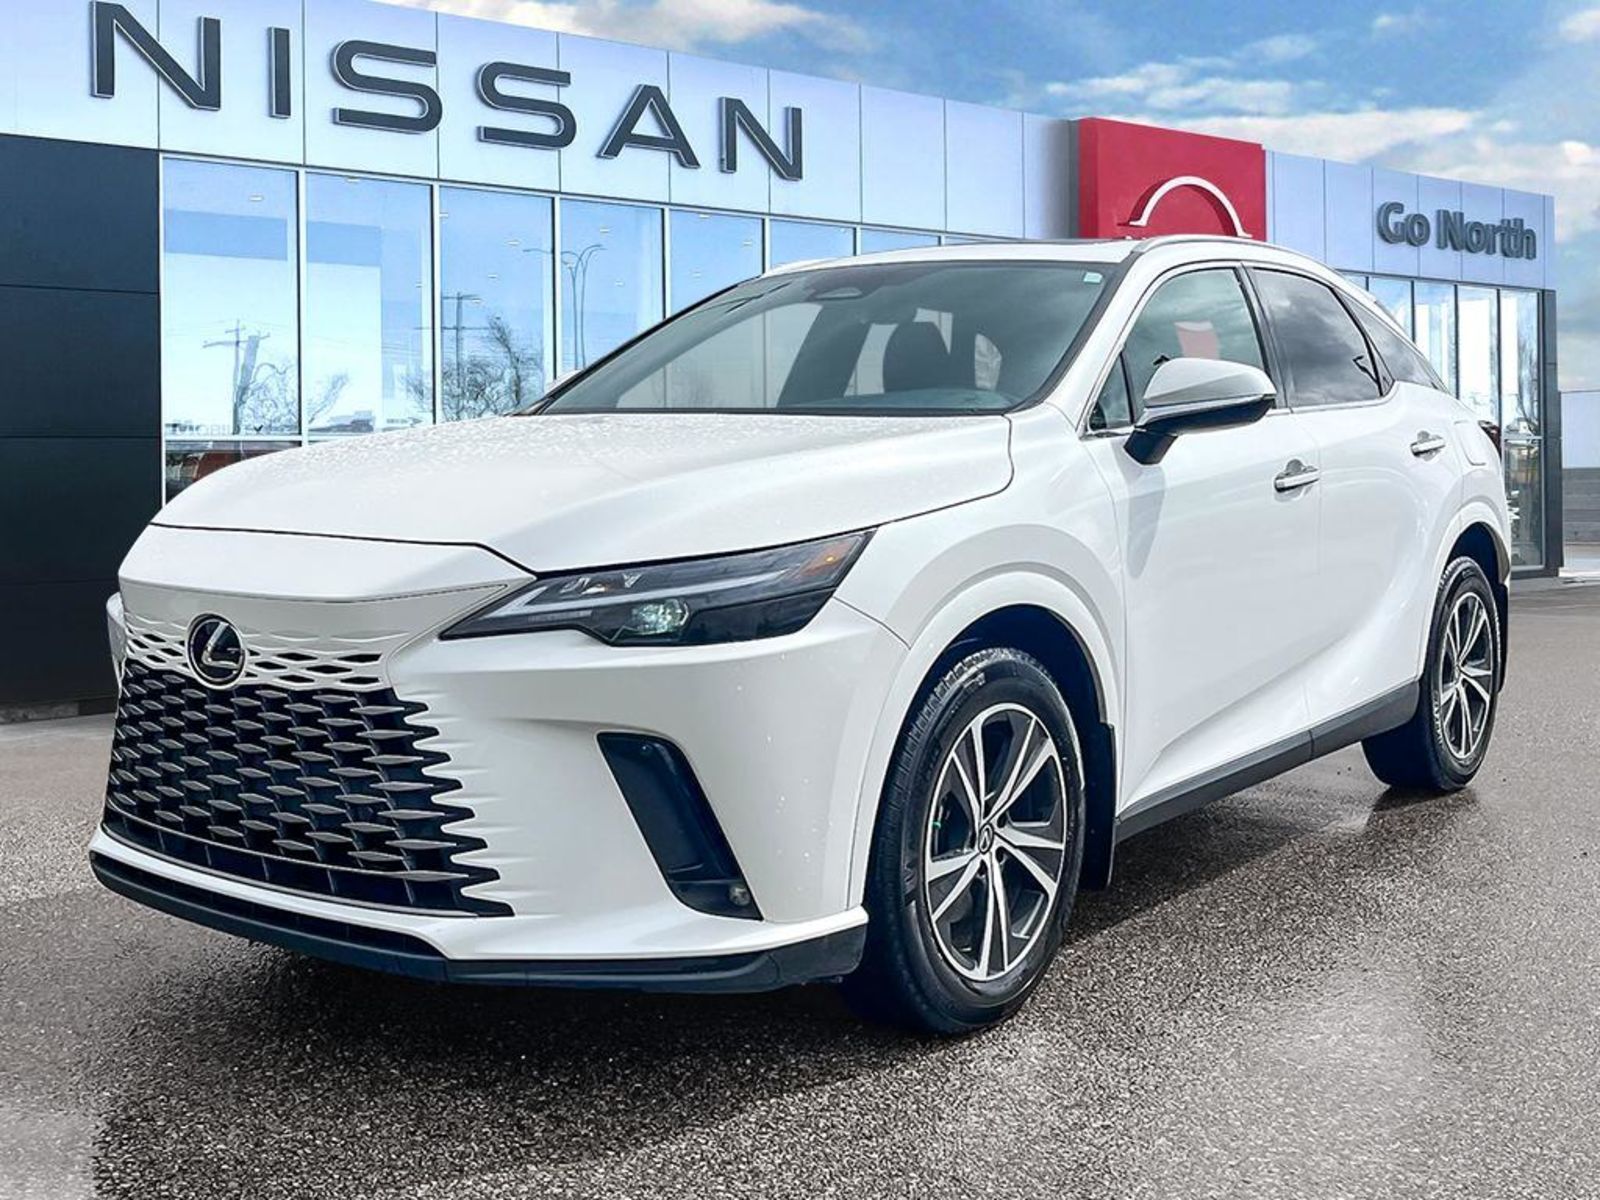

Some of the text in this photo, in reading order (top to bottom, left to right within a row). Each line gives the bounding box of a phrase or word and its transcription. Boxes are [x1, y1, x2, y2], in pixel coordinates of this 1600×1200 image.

[90, 1, 803, 182] NISSAN
[1377, 201, 1537, 260] Go North
